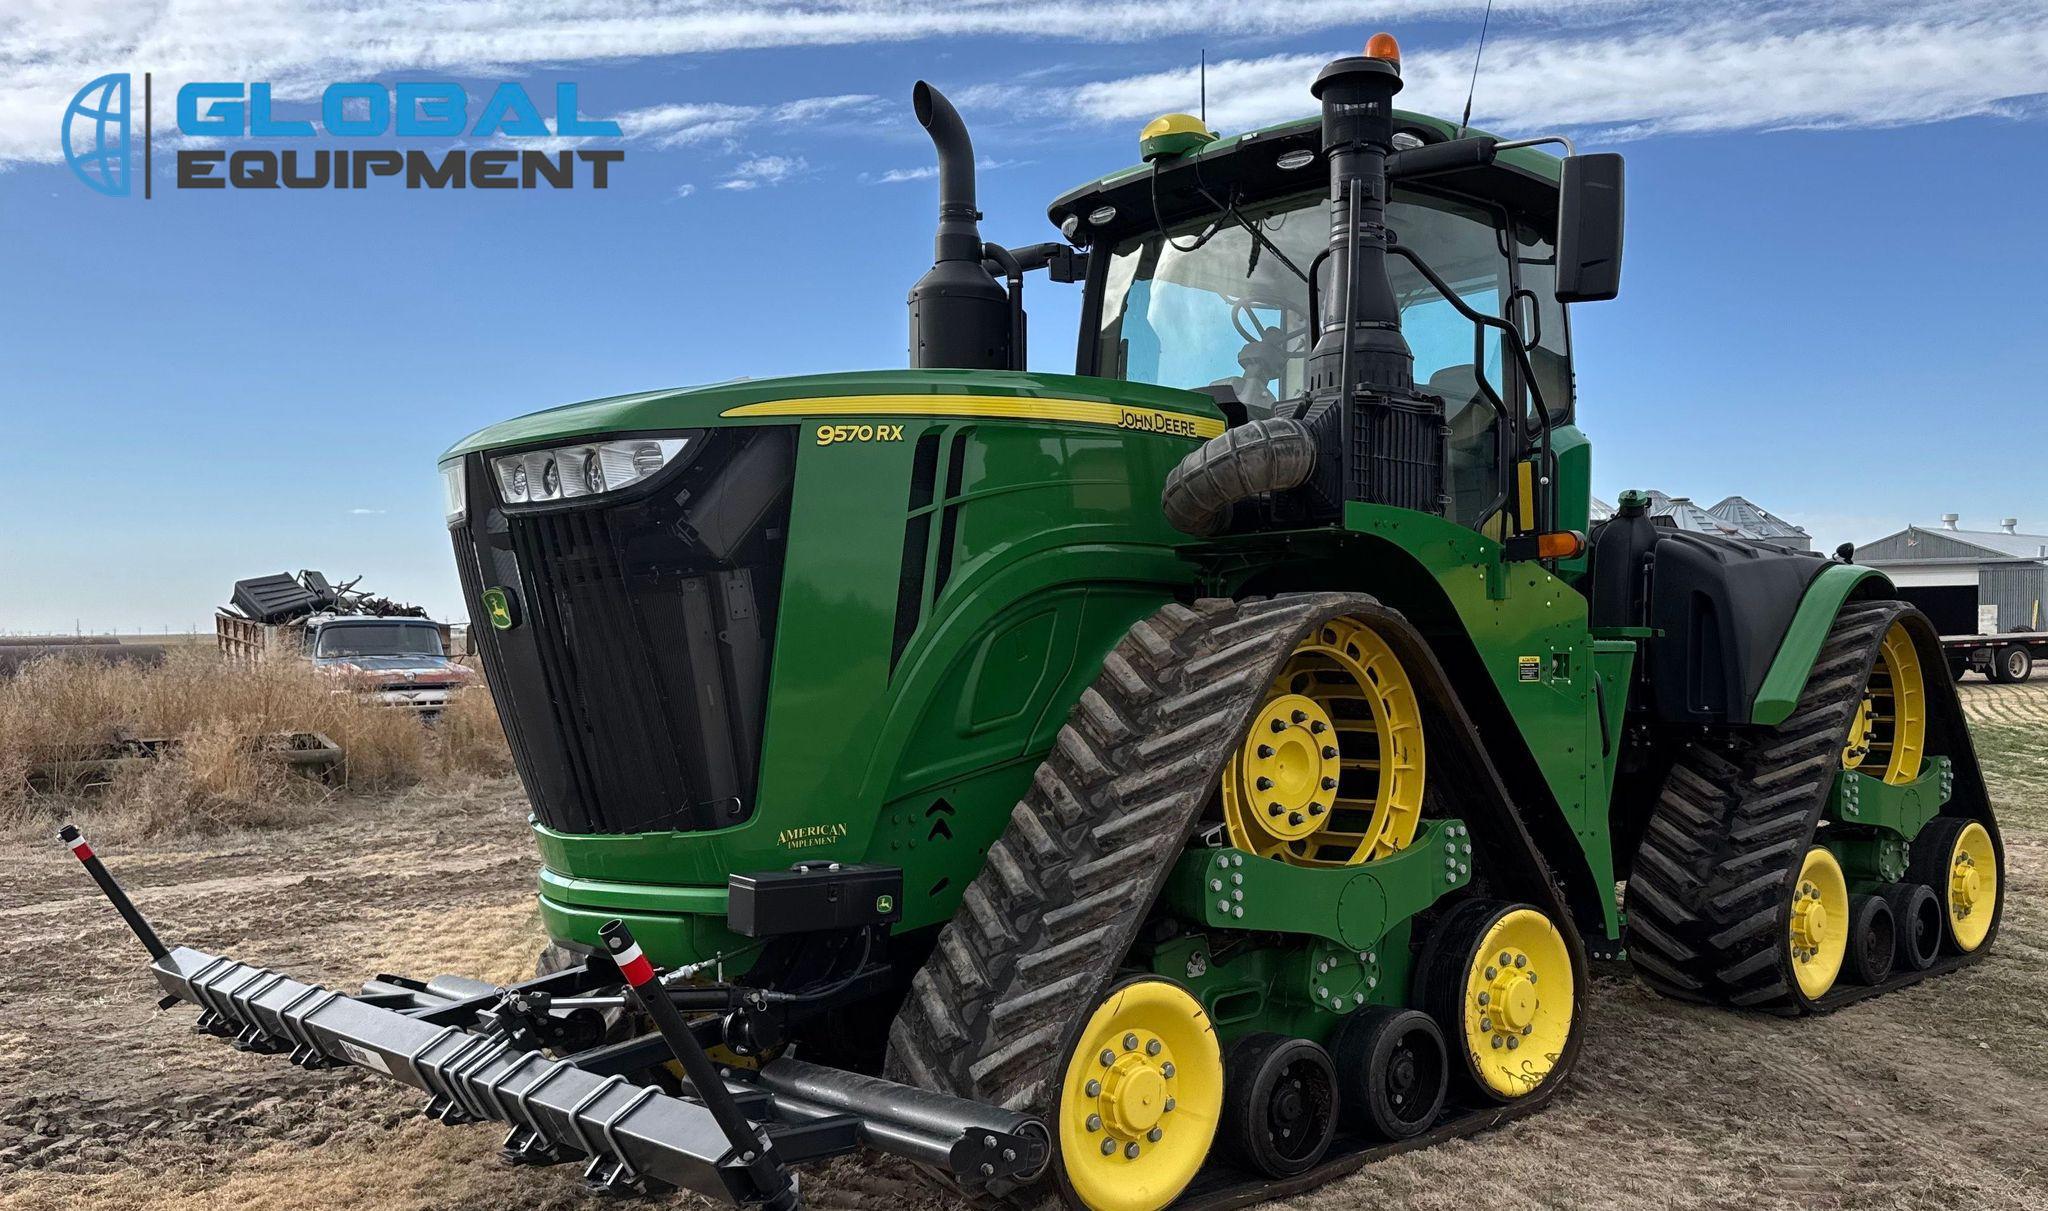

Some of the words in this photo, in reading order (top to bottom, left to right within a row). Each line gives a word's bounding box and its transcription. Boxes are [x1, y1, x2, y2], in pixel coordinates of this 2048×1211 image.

[1118, 409, 1153, 430] JOHN
[1154, 413, 1197, 436] DEERE
[816, 424, 874, 446] 9570
[876, 424, 905, 442] RX
[776, 823, 848, 846] AMERICAN
[788, 835, 837, 850] IMPLEMENT
